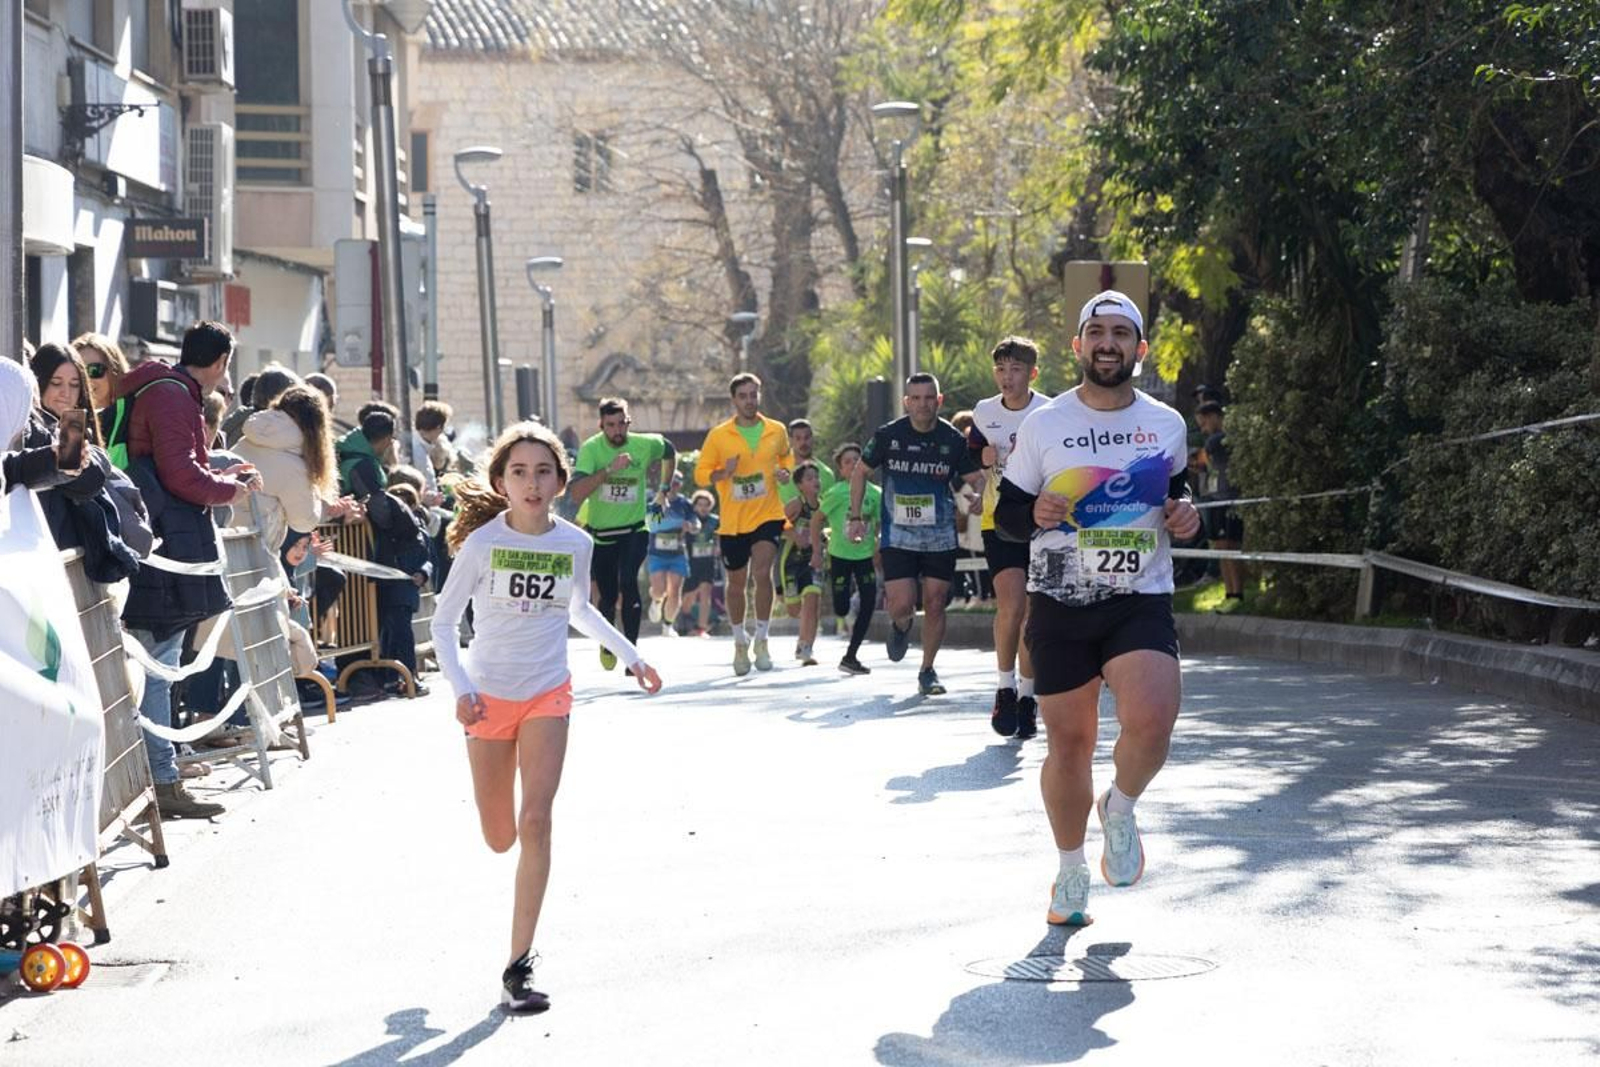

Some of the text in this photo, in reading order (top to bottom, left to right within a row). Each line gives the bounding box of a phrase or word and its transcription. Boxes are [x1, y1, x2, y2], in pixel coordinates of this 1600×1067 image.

[134, 225, 197, 241] Mahou
[888, 459, 950, 474] SAN ANTÓN
[611, 485, 628, 497] 132
[742, 483, 755, 495] 93
[905, 506, 922, 518] 116
[1096, 550, 1140, 573] 229
[509, 572, 556, 600] 662
